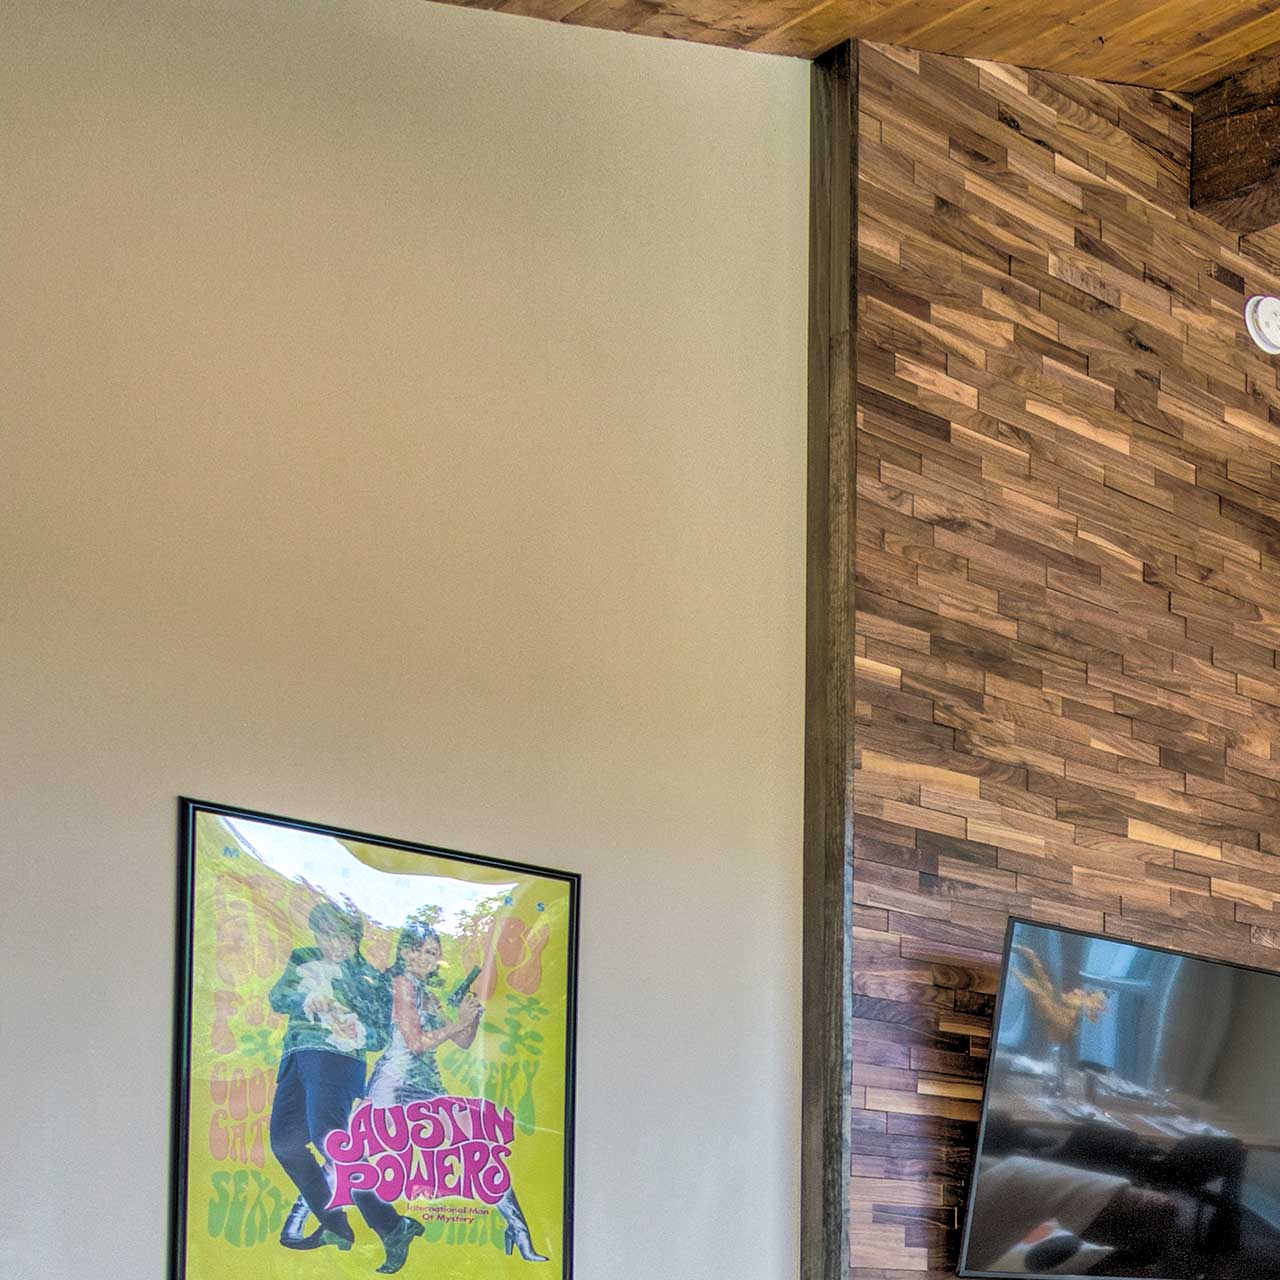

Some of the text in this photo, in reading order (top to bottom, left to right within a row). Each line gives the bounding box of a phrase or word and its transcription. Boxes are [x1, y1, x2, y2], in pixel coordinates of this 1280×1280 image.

[325, 1096, 514, 1163] AUSTIN
[324, 1141, 512, 1210] POWERS
[407, 1202, 489, 1216] International Man
[437, 1214, 474, 1224] Mystery
